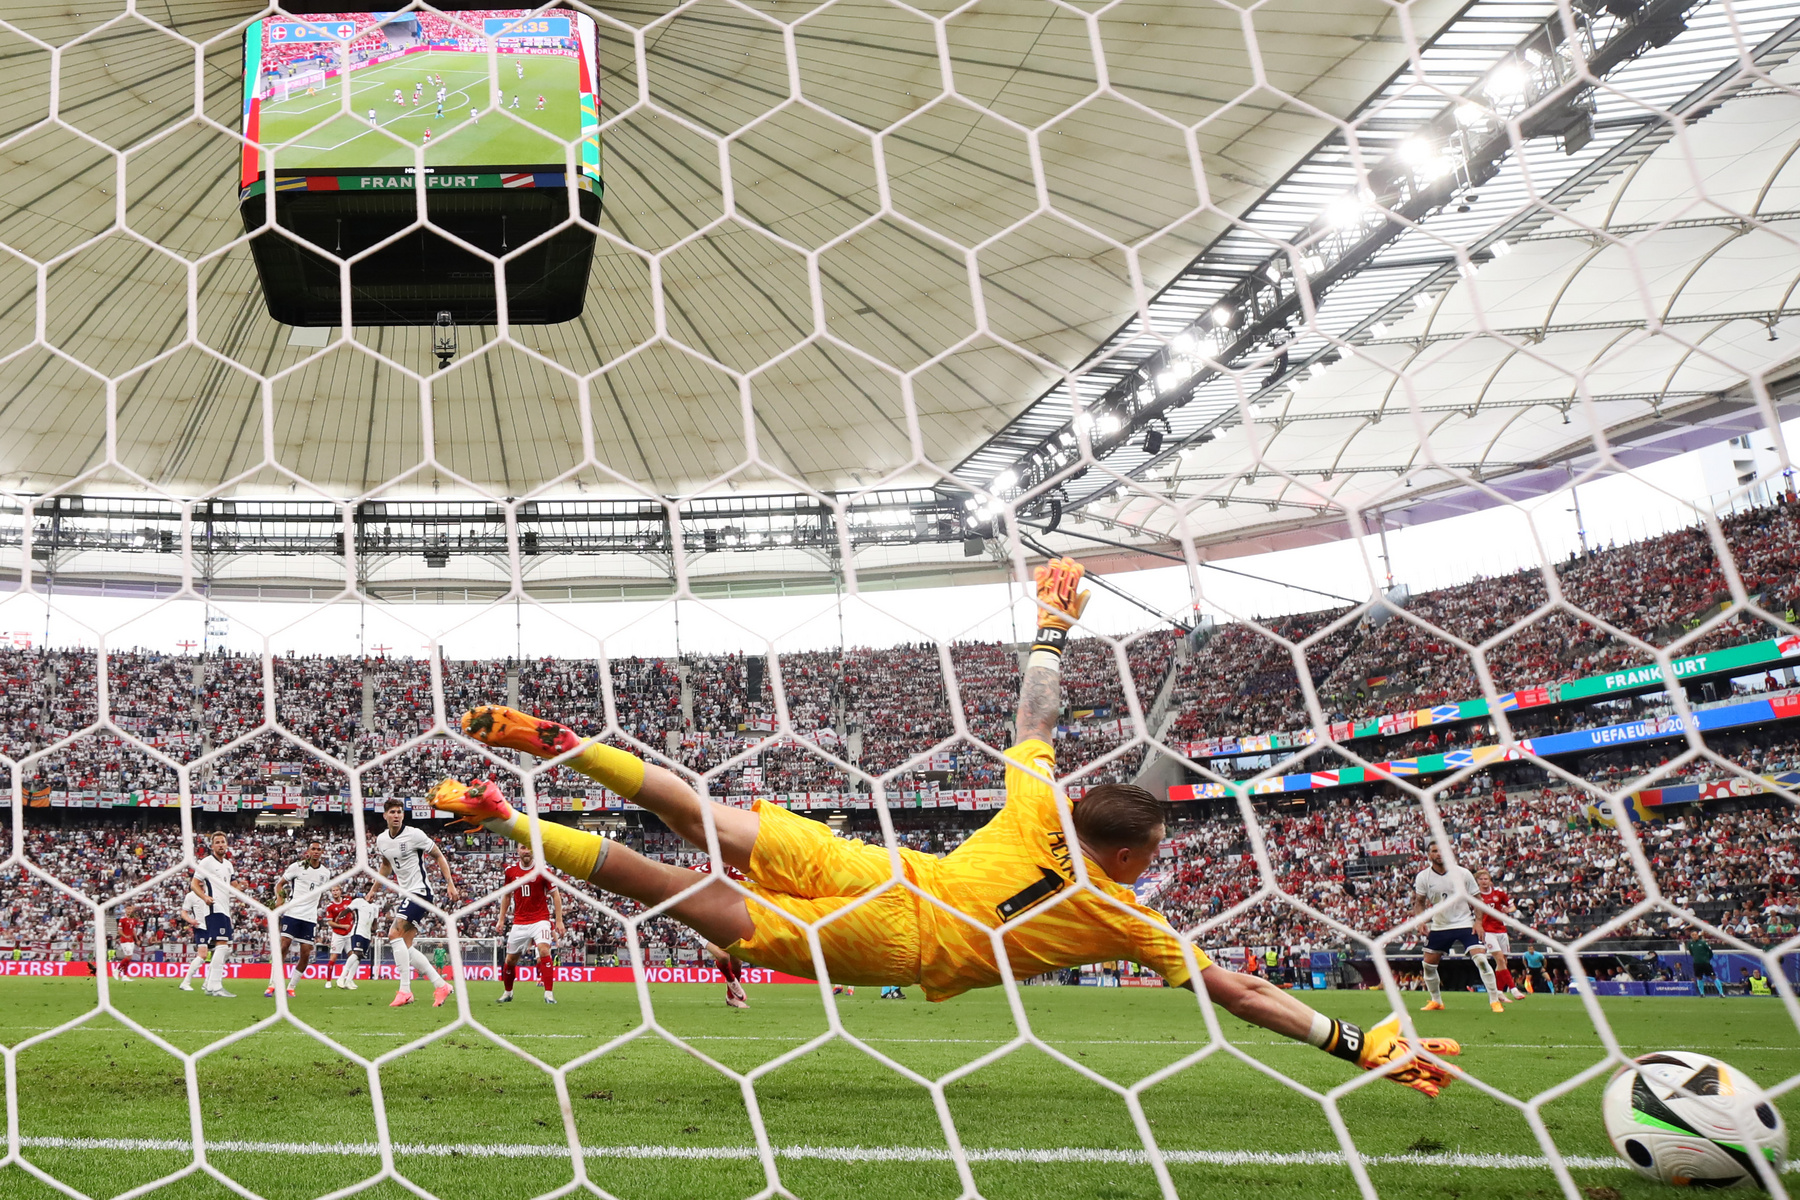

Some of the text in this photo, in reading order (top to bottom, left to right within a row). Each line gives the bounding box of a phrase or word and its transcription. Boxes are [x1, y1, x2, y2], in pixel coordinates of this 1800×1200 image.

[361, 176, 479, 188] FRANFURT
[1037, 629, 1062, 642] JP
[1605, 657, 1707, 689] FRANKURT
[393, 857, 401, 869] 5
[309, 882, 315, 891] 8
[521, 884, 531, 897] 10
[541, 930, 550, 940] 10
[286, 965, 416, 980] WORLFRST
[463, 967, 596, 981] WODRST
[645, 968, 775, 983] WORLDFRST
[1342, 1024, 1360, 1051] JP
